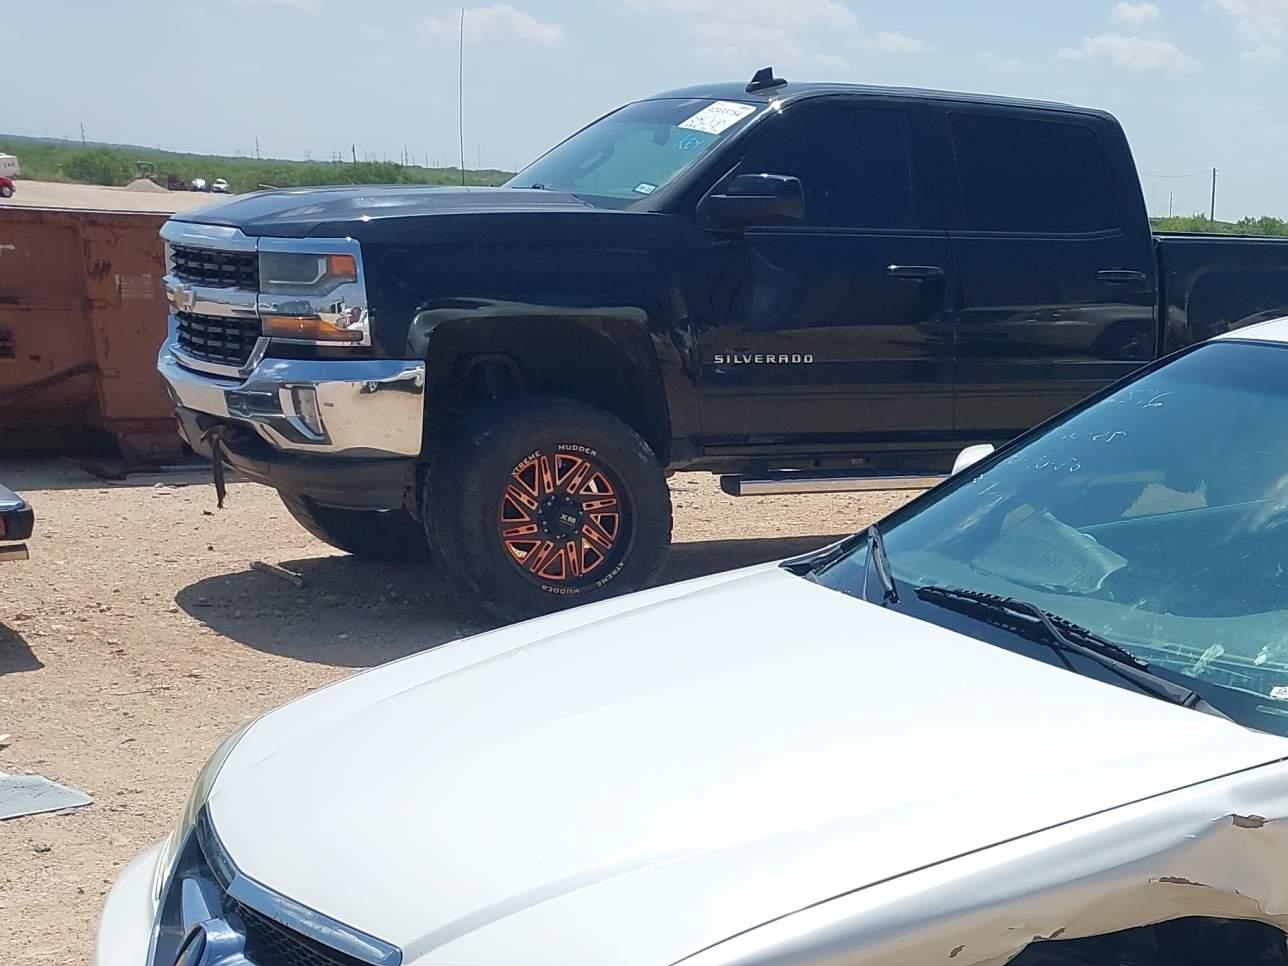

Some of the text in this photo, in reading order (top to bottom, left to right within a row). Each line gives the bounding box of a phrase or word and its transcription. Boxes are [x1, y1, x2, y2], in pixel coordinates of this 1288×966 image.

[714, 354, 814, 364] SILVERADO
[511, 444, 597, 476] XTREME MUDDER
